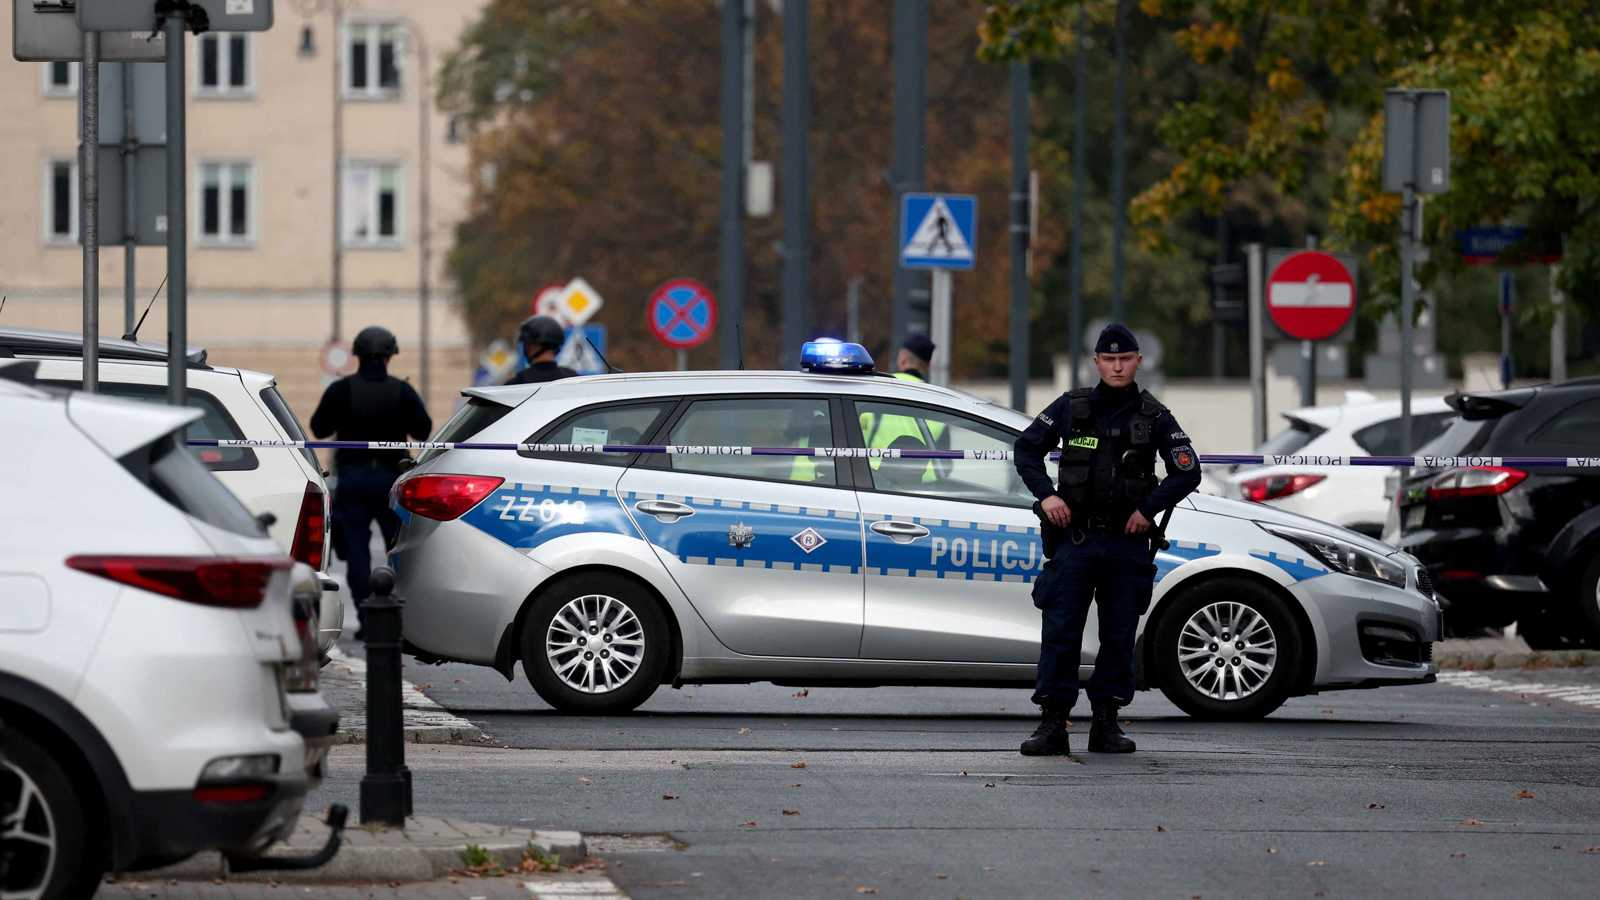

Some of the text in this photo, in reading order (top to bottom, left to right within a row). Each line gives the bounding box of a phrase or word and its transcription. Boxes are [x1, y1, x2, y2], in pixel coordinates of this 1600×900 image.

[526, 443, 596, 453] POLICJA
[675, 445, 744, 456] POLICJA
[823, 447, 892, 459] POLICJA
[973, 449, 1009, 461] ICJA
[1272, 455, 1342, 465] POLICJA
[1424, 456, 1494, 467] POLICJA
